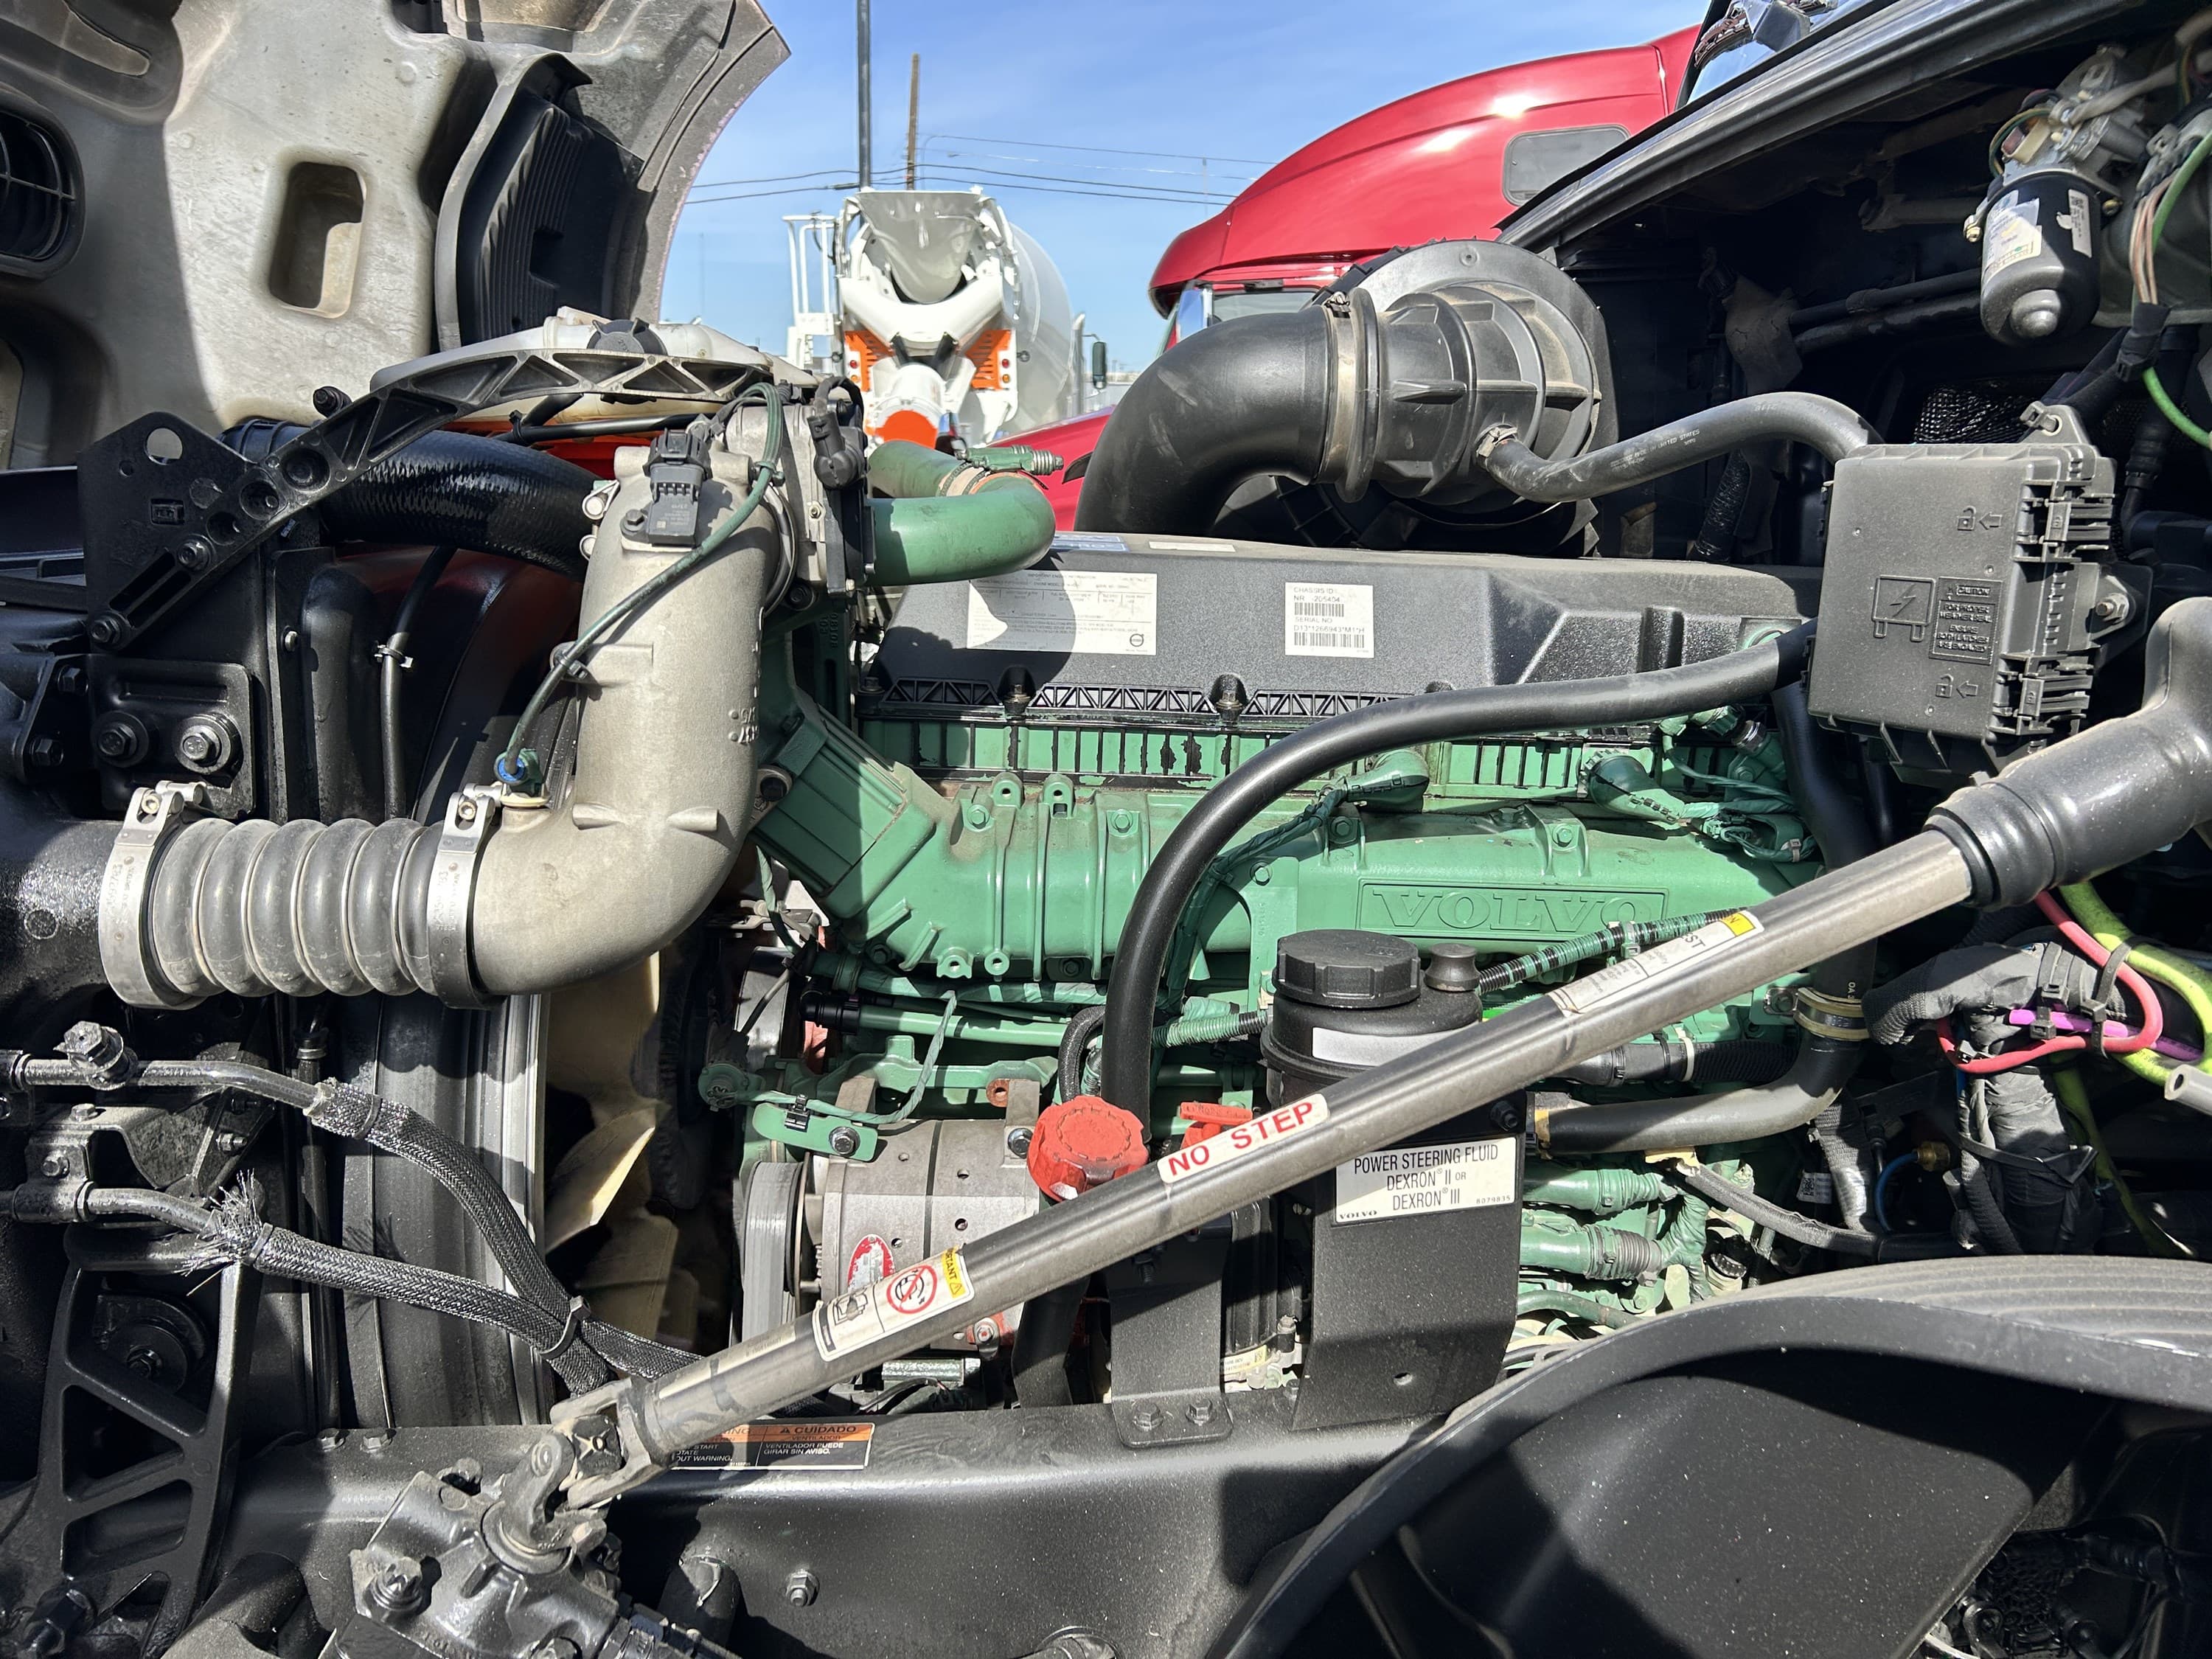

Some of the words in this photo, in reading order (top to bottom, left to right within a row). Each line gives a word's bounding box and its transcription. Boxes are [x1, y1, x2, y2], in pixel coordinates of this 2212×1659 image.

[1680, 428, 1700, 441] STATES
[1293, 586, 1325, 594] CHASSIS
[1372, 890, 1652, 933] VOLVO
[1168, 1144, 1210, 1176] NO
[1231, 1102, 1312, 1150] STEP
[1354, 1155, 1398, 1175] POWER
[1402, 1147, 1461, 1169] STEERING
[1464, 1144, 1498, 1163] FLUID
[1455, 1171, 1467, 1181] OR
[1450, 1188, 1460, 1205] III
[1475, 1194, 1512, 1205] 8079835
[1338, 1209, 1377, 1220] VOLVO
[793, 1425, 857, 1434] CUIDADO
